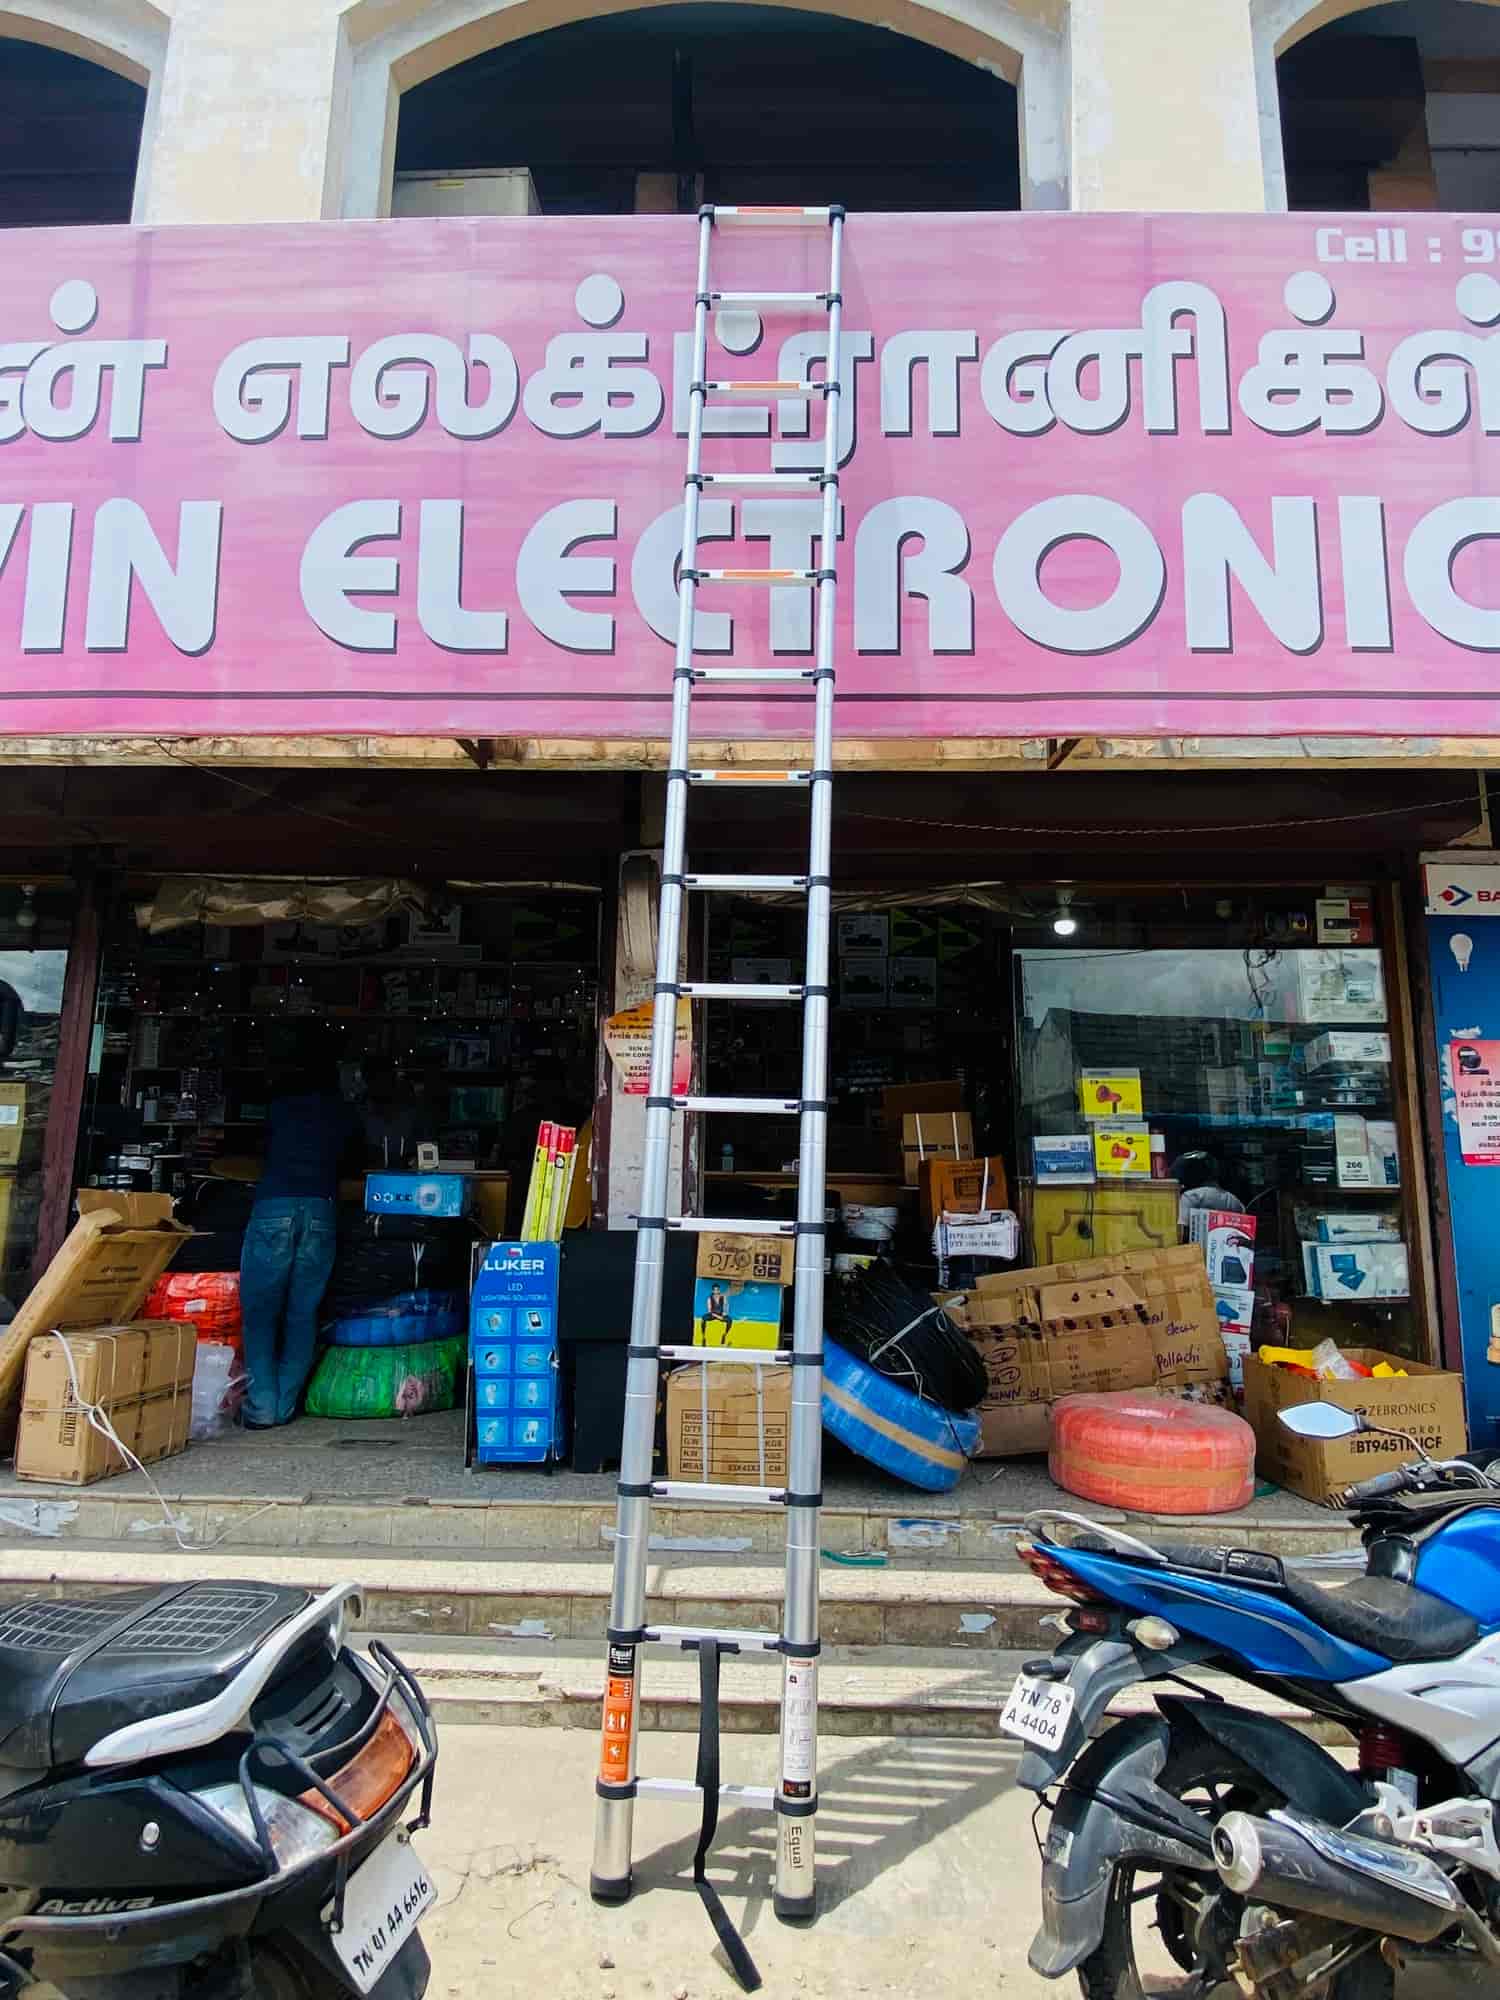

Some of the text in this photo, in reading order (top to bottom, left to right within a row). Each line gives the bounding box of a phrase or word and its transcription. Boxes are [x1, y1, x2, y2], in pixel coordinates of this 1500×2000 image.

[1316, 227, 1408, 263] Cell
[1461, 228, 1500, 263] 9
[0, 497, 223, 657] IN
[484, 1259, 545, 1271] LUKER
[507, 1282, 523, 1292] LED
[1367, 1402, 1436, 1417] ZEBRONICS
[1020, 1687, 1062, 1715] TN 78
[1006, 1706, 1057, 1739] A 4404
[789, 1826, 804, 1869] Equal
[37, 1896, 154, 1913] Activa
[352, 1943, 374, 1977] TN
[403, 1873, 428, 1914] 6616
